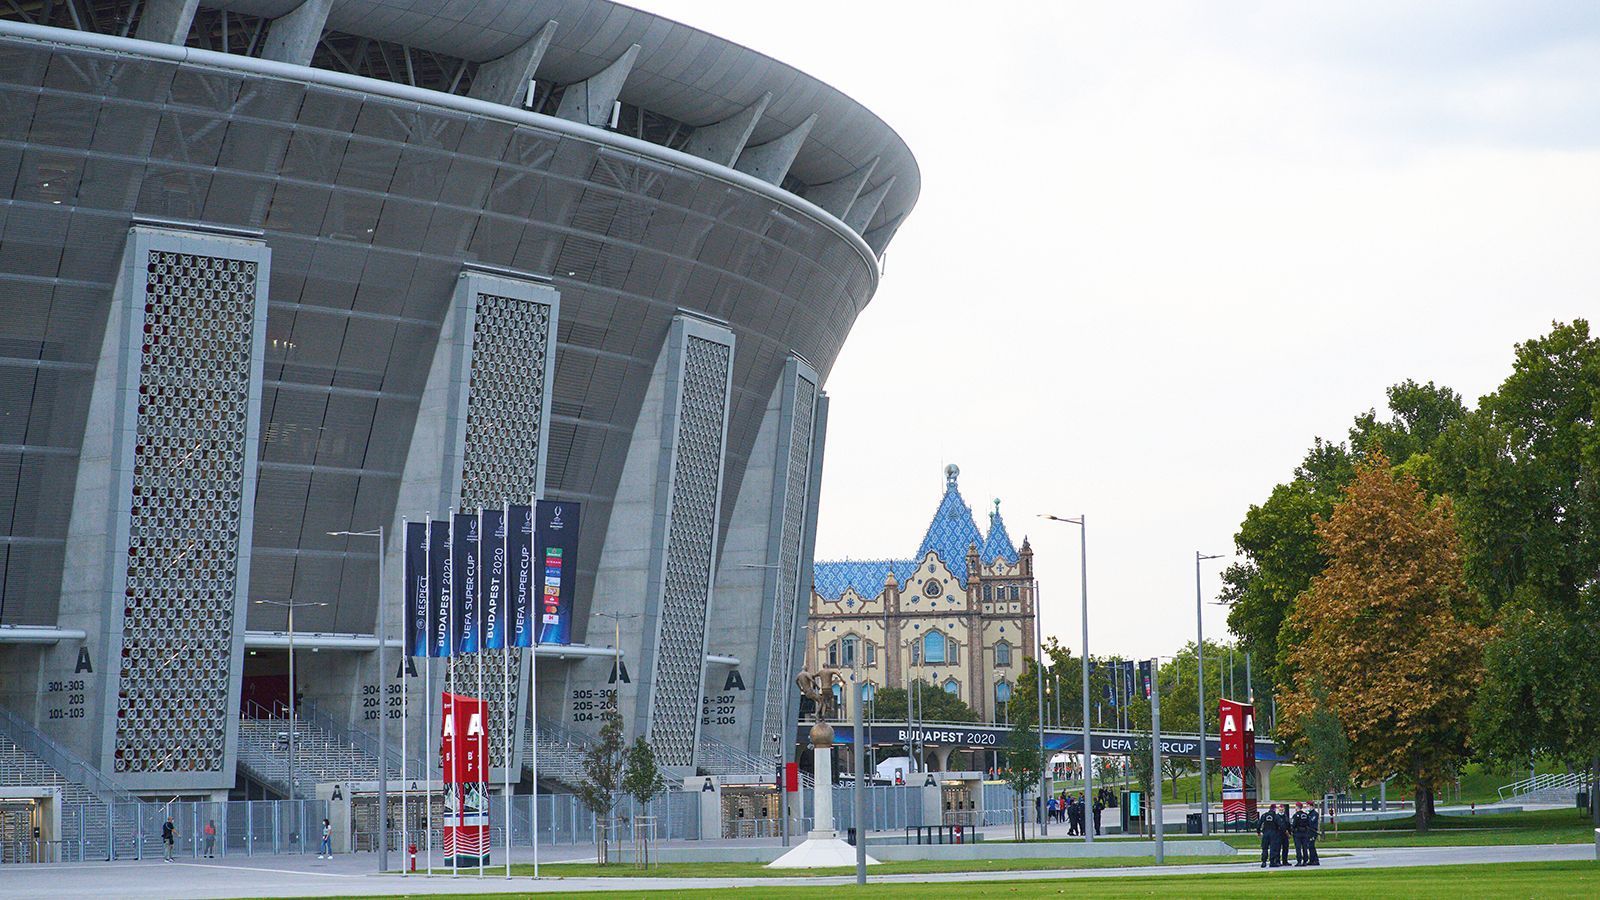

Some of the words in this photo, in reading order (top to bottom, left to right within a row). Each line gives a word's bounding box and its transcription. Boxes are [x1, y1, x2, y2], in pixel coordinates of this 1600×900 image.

[493, 547, 504, 575] 2020
[442, 559, 452, 585] 2020
[418, 575, 428, 616] RESPECT
[438, 587, 450, 647] BUDAPEST
[487, 577, 500, 639] BUDAPEST
[464, 612, 472, 639] UEFA
[516, 606, 525, 634] UEFA
[75, 646, 93, 673] A
[608, 661, 631, 684] A
[723, 670, 746, 691] A
[48, 680, 85, 692] 301-303
[69, 694, 85, 705] 203
[49, 708, 85, 719] 101-103
[1223, 714, 1237, 732] A
[1245, 714, 1254, 731] A
[467, 713, 484, 736] A
[898, 730, 963, 743] BUDAPEST
[967, 733, 995, 745] 2020
[1102, 739, 1131, 751] UEFA
[411, 781, 418, 790] A
[702, 777, 715, 792] A
[923, 774, 937, 787] A
[331, 784, 343, 801] A
